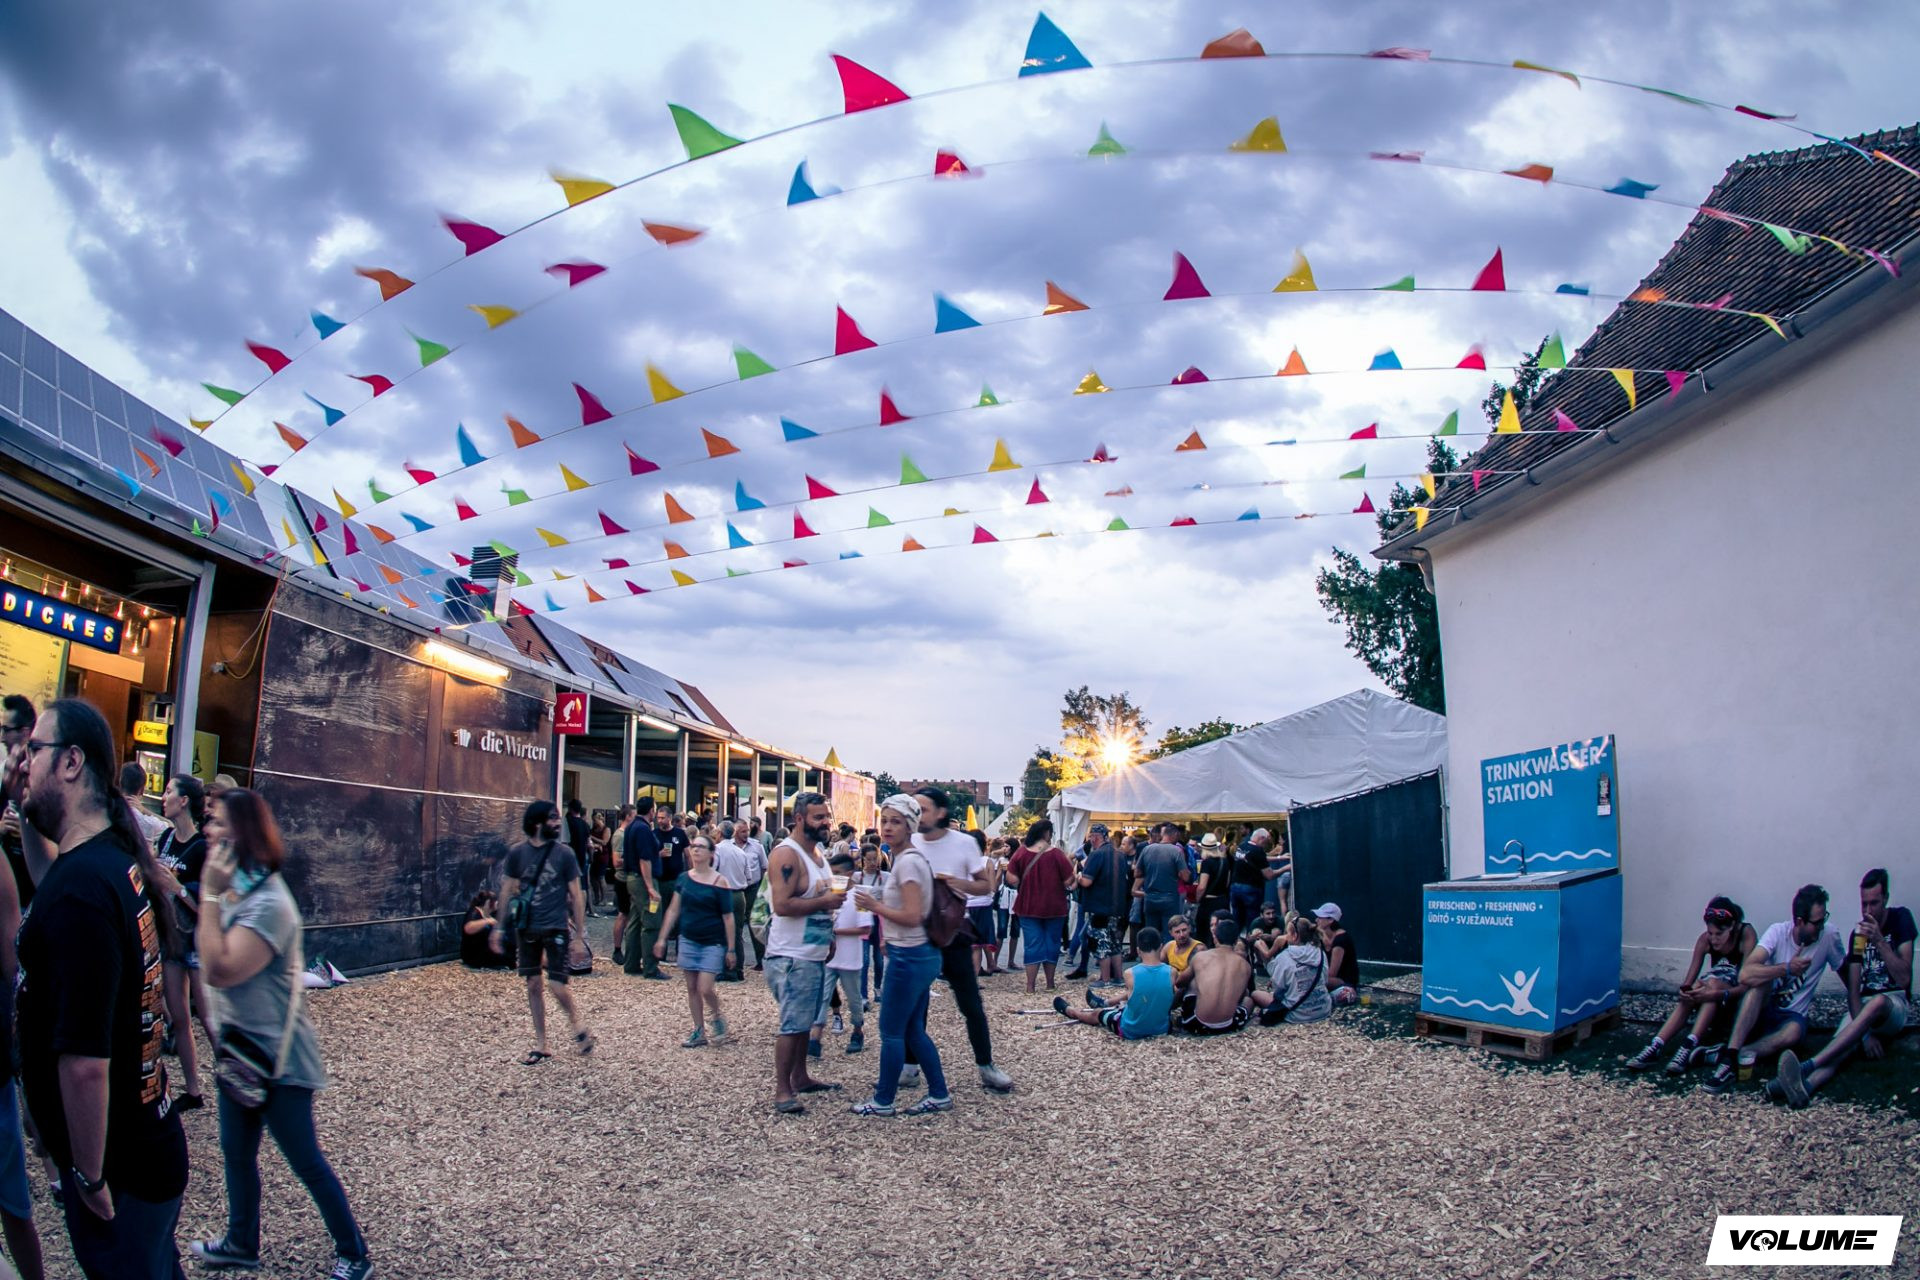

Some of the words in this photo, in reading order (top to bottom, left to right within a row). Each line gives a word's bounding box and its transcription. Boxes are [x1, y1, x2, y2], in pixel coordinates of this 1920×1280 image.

[3, 592, 115, 643] DICKES
[480, 729, 504, 754] die
[505, 734, 548, 762] Wirten
[1487, 778, 1554, 805] STATION
[1427, 900, 1477, 911] ERFRISCHEND
[1484, 901, 1537, 912] FRESHENING
